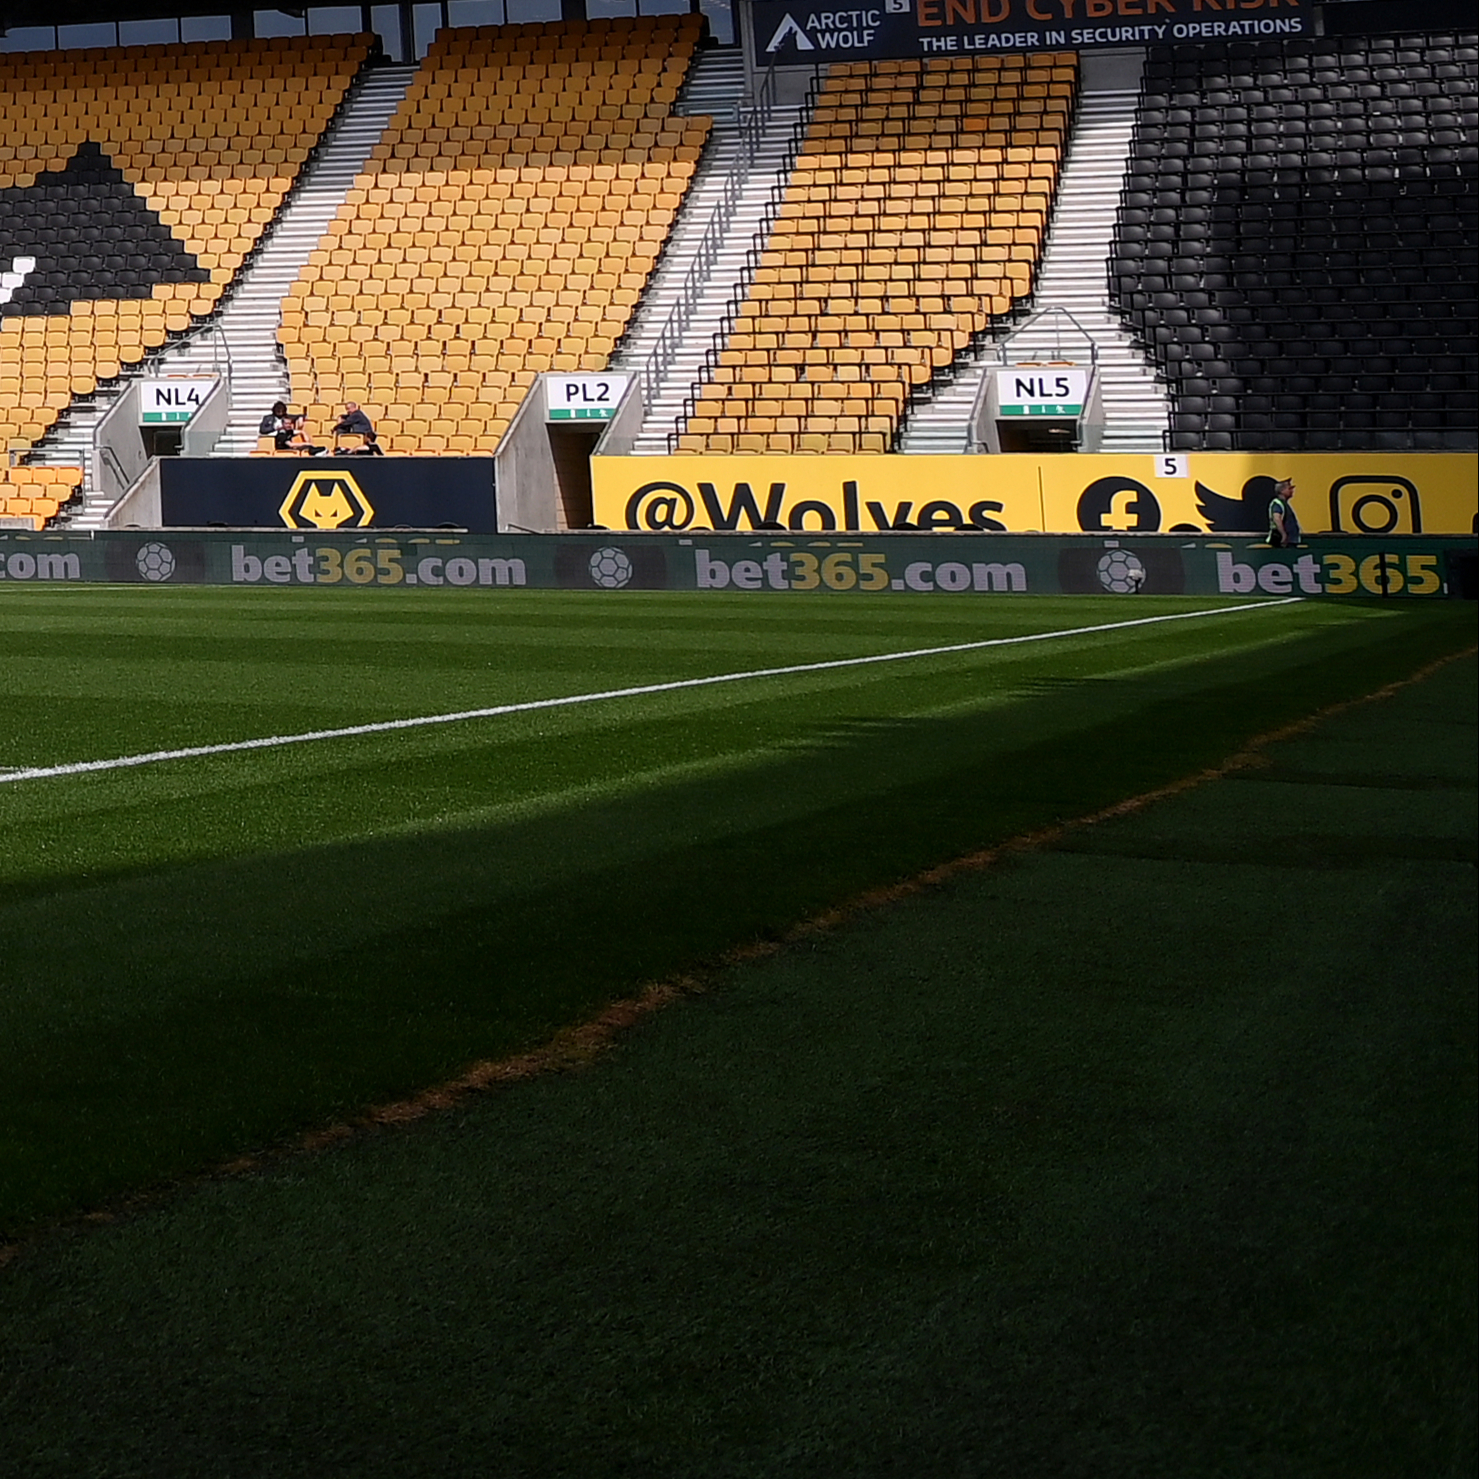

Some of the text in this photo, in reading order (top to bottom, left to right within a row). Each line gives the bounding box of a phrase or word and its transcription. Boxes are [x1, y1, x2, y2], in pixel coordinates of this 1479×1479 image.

[806, 10, 881, 31] ARCTIC
[817, 30, 876, 50] WOLF
[919, 17, 1303, 52] THE LEADER IN SECURITY OPERATIONS
[154, 387, 201, 407] NL4
[565, 382, 611, 403] PL2
[1014, 377, 1070, 399] NL5
[1163, 457, 1178, 475] 5
[625, 480, 1007, 531] @Wolves
[231, 544, 527, 587] bet365.com
[694, 548, 1028, 593] bet365.com
[1215, 550, 1447, 596] bet365
